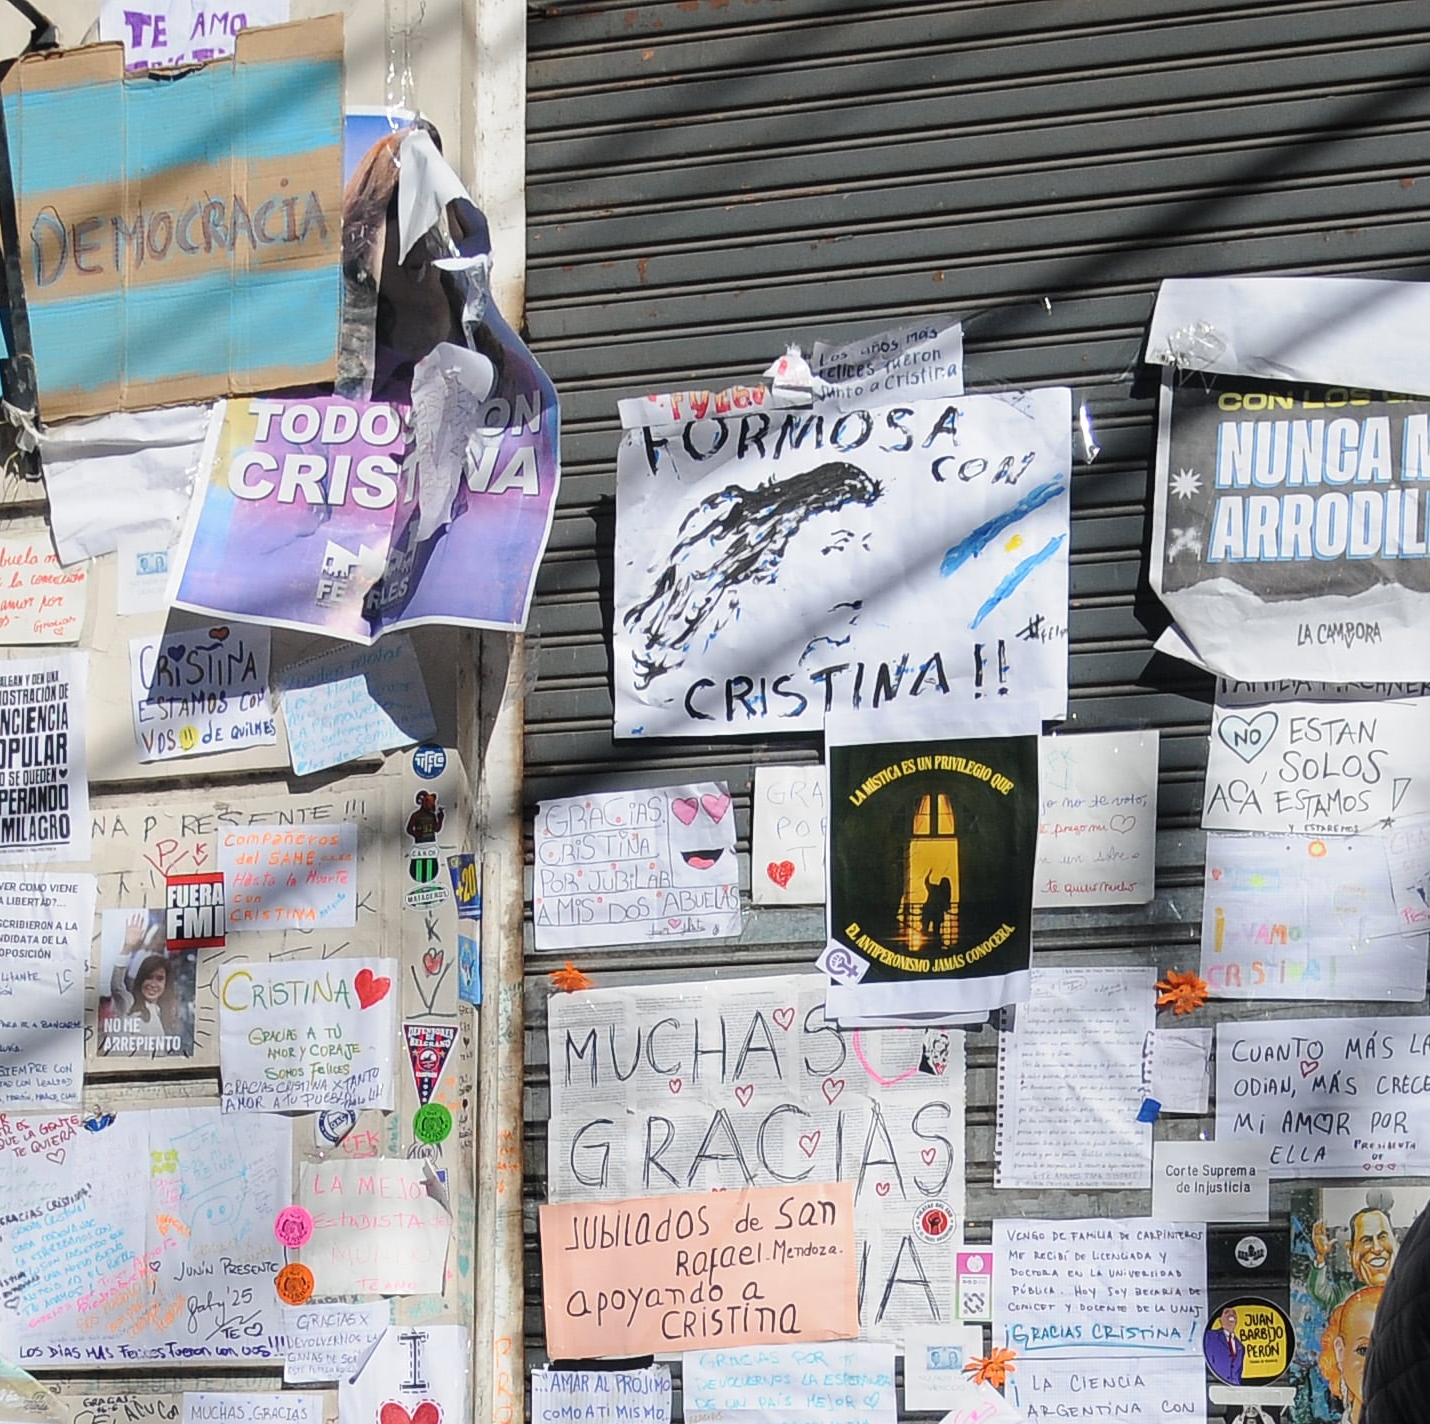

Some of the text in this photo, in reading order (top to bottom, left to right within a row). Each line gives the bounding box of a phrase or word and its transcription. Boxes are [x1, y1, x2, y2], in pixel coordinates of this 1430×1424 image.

[32, 191, 328, 290] DEMOCRACIA
[644, 406, 1036, 485] FORMOSA CON
[1216, 414, 1392, 489] NUNCA
[227, 445, 541, 510] CRISTNA
[1298, 623, 1312, 646] LA
[685, 651, 952, 723] CRISTINA
[9, 770, 21, 785] SE
[24, 768, 57, 785] QUEDEN
[849, 755, 1015, 807] LA MÍSTICA ES UN PRIVILEGIO QUE
[0, 813, 71, 844] MILAGRO
[19, 882, 46, 893] COMO
[49, 882, 79, 894] VIENE
[167, 882, 224, 908] FUERA
[55, 920, 64, 931] A
[65, 920, 78, 931] LA
[167, 908, 224, 940] FMI
[41, 933, 54, 944] DE
[56, 934, 68, 945] LA
[845, 922, 860, 940] EL
[859, 934, 930, 972] ANTIPERONISMO
[931, 951, 965, 972] JAMÁS
[104, 1018, 140, 1032] NO ME
[103, 1035, 181, 1052] ARREPIENTO
[564, 1003, 847, 1090] MUCHAS
[568, 1099, 957, 1201] GRACIAS
[1165, 1163, 1257, 1180] Corte Suprema
[1176, 1179, 1252, 1196] de Injusticia
[1244, 1312, 1274, 1328] JUAN
[396, 1331, 431, 1394] I
[1246, 1341, 1280, 1358] PERÓN
[190, 1404, 309, 1422] MUCHAS GRACIAS
